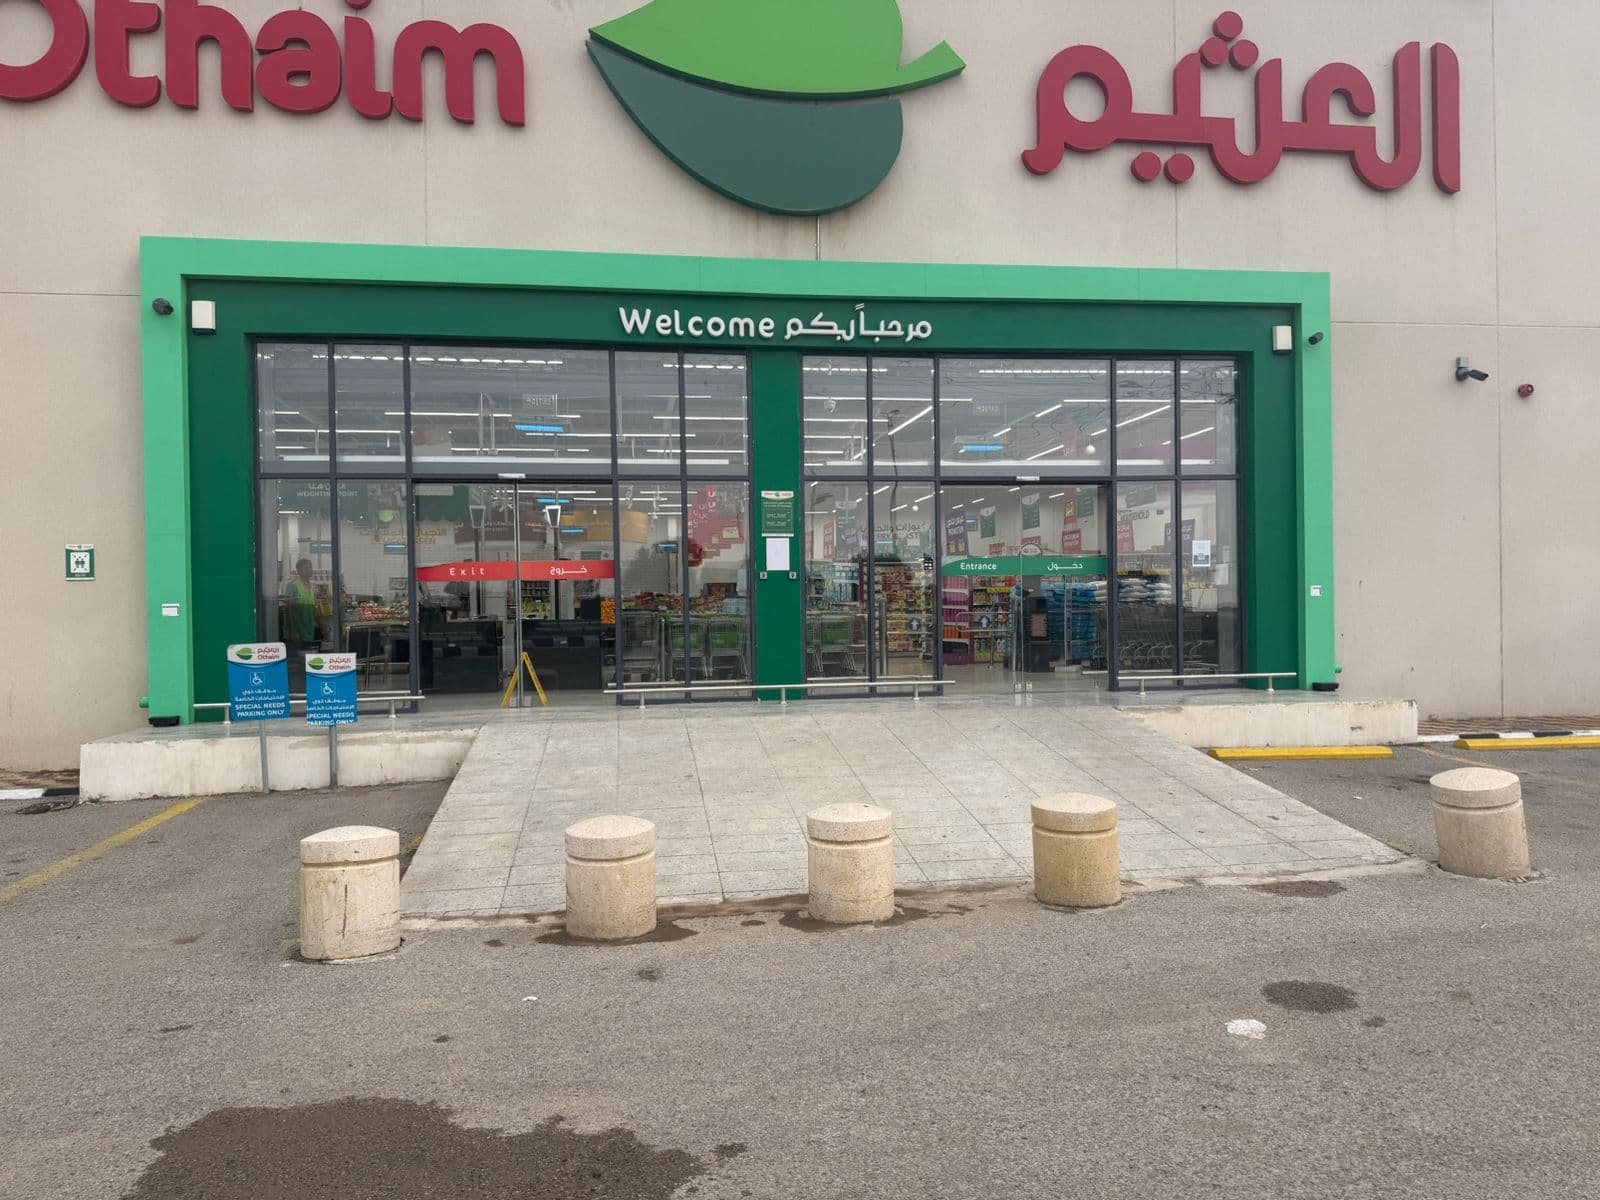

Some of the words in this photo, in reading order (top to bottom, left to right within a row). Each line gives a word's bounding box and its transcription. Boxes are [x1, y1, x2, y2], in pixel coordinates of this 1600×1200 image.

[1022, 11, 1461, 193] العثيم
[618, 307, 776, 338] Welcome
[550, 565, 588, 575] خروج
[960, 562, 998, 571] Entrance
[1047, 562, 1084, 571] دخول
[449, 567, 485, 576] Exit
